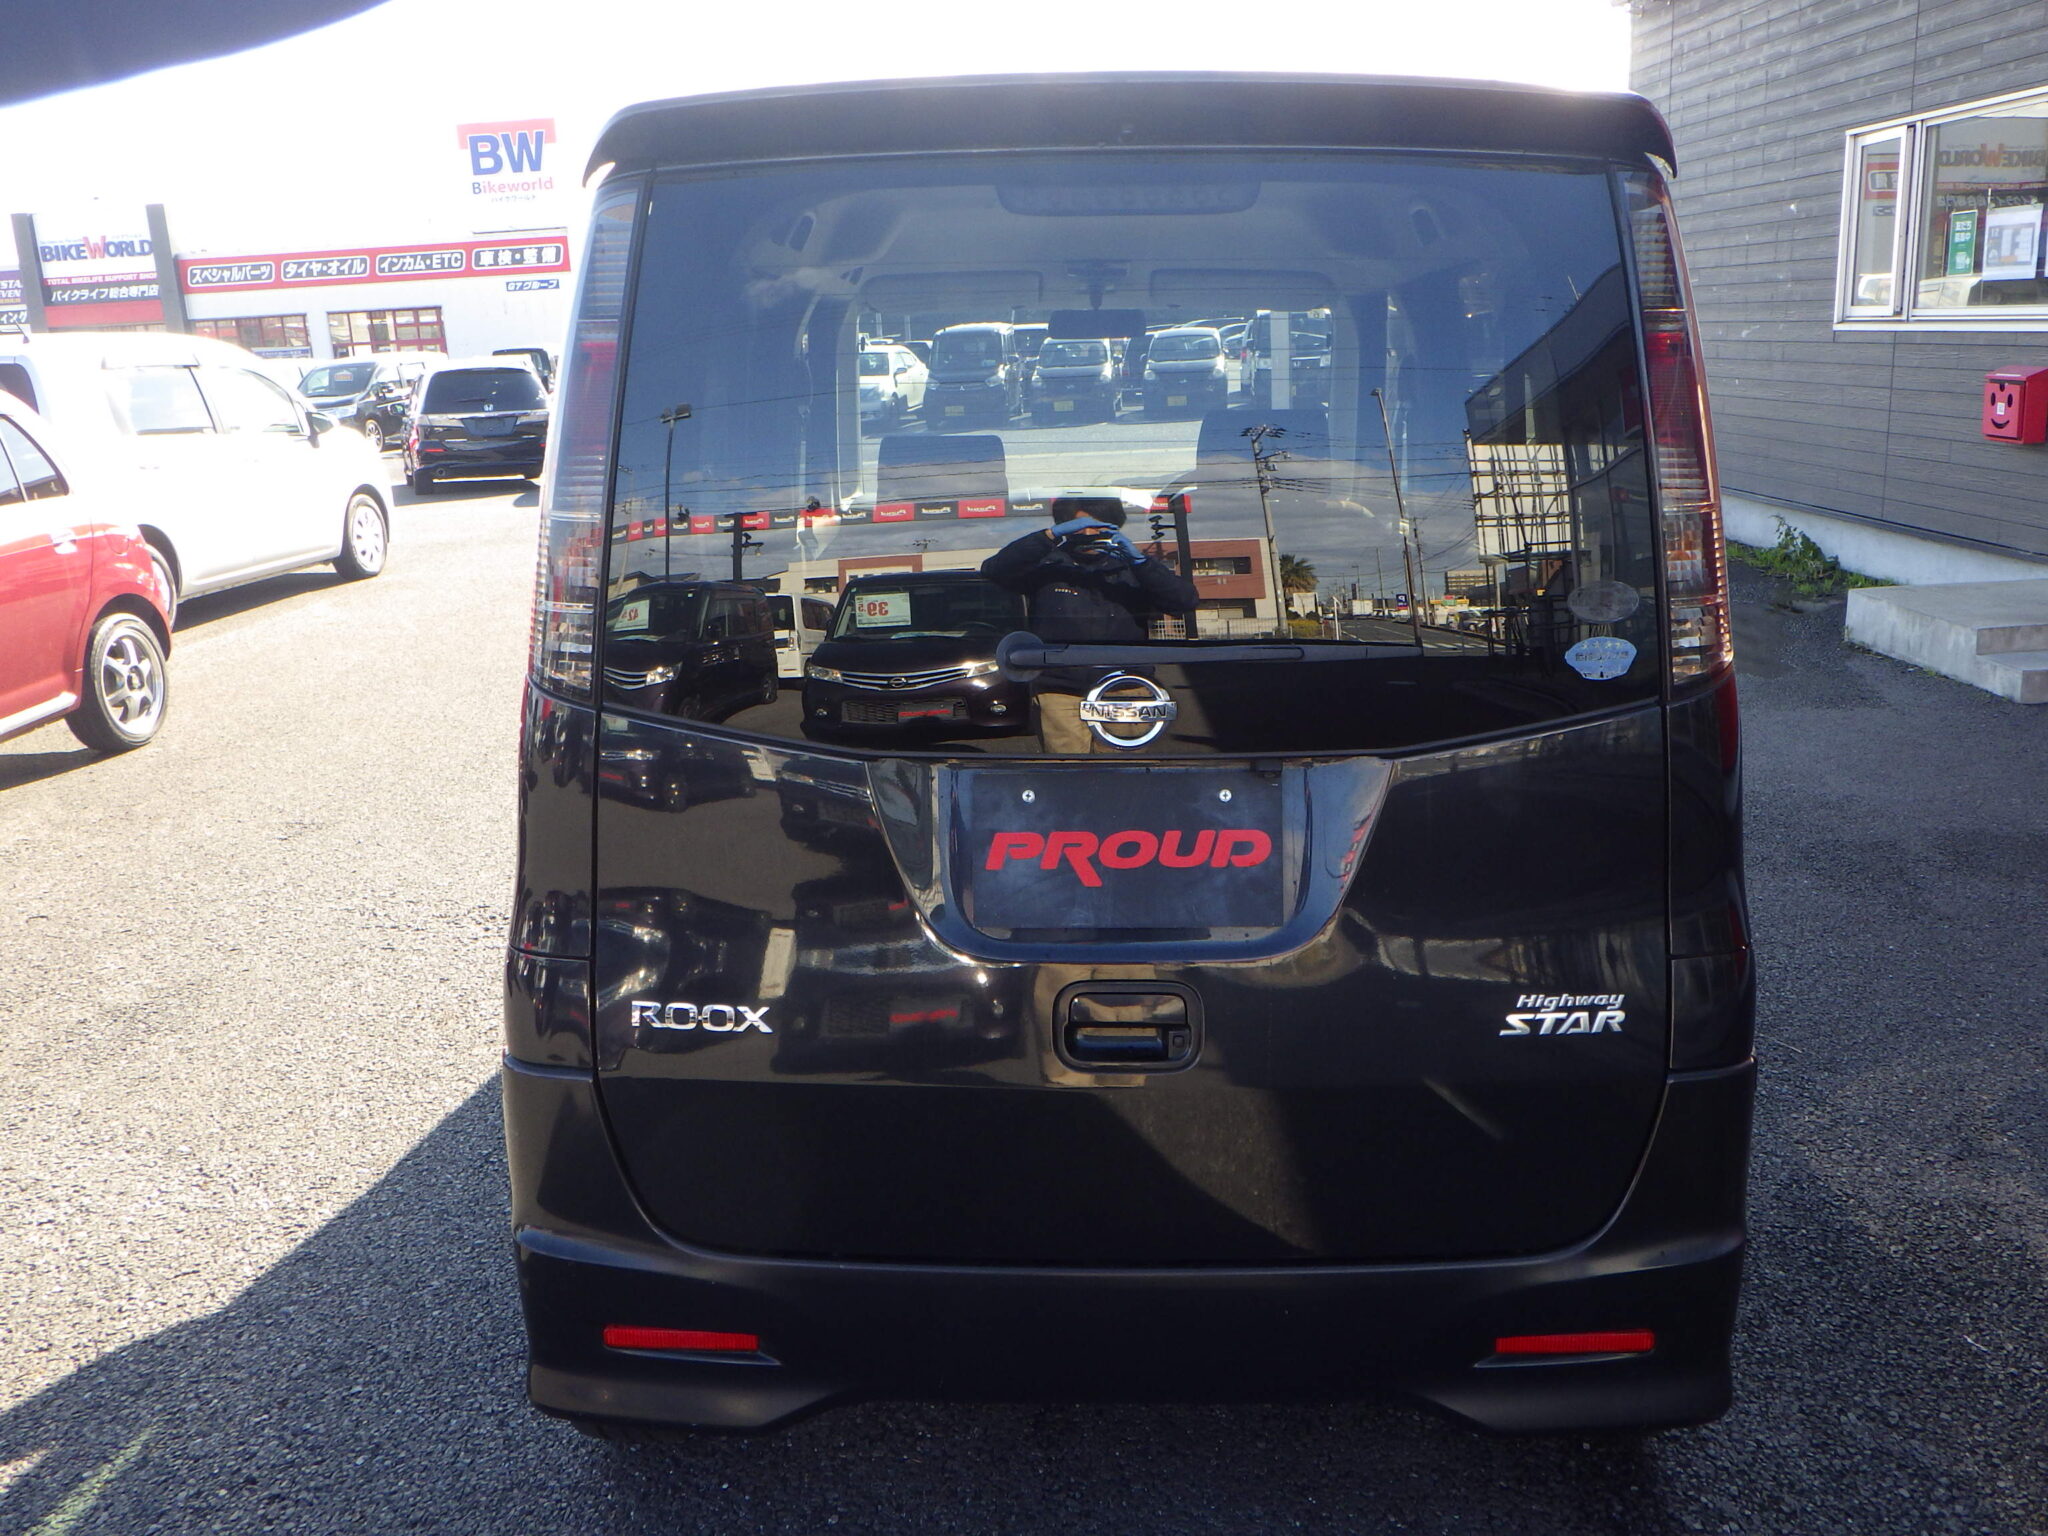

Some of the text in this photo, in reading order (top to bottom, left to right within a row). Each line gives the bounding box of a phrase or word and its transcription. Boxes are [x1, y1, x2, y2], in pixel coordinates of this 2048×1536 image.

[468, 130, 545, 176] BW
[471, 177, 554, 195] Bikeworld
[40, 236, 154, 262] BIKEWORLD
[47, 278, 70, 286] TOTAL
[191, 264, 272, 284] スペシャルパーツ
[51, 284, 160, 302] バイクライフ総合専門店
[1090, 703, 1168, 719] NISSAN
[985, 829, 1272, 887] PROUD
[1516, 993, 1625, 1013] Highway
[631, 1000, 773, 1033] ROOX
[1499, 1010, 1626, 1036] STAR
